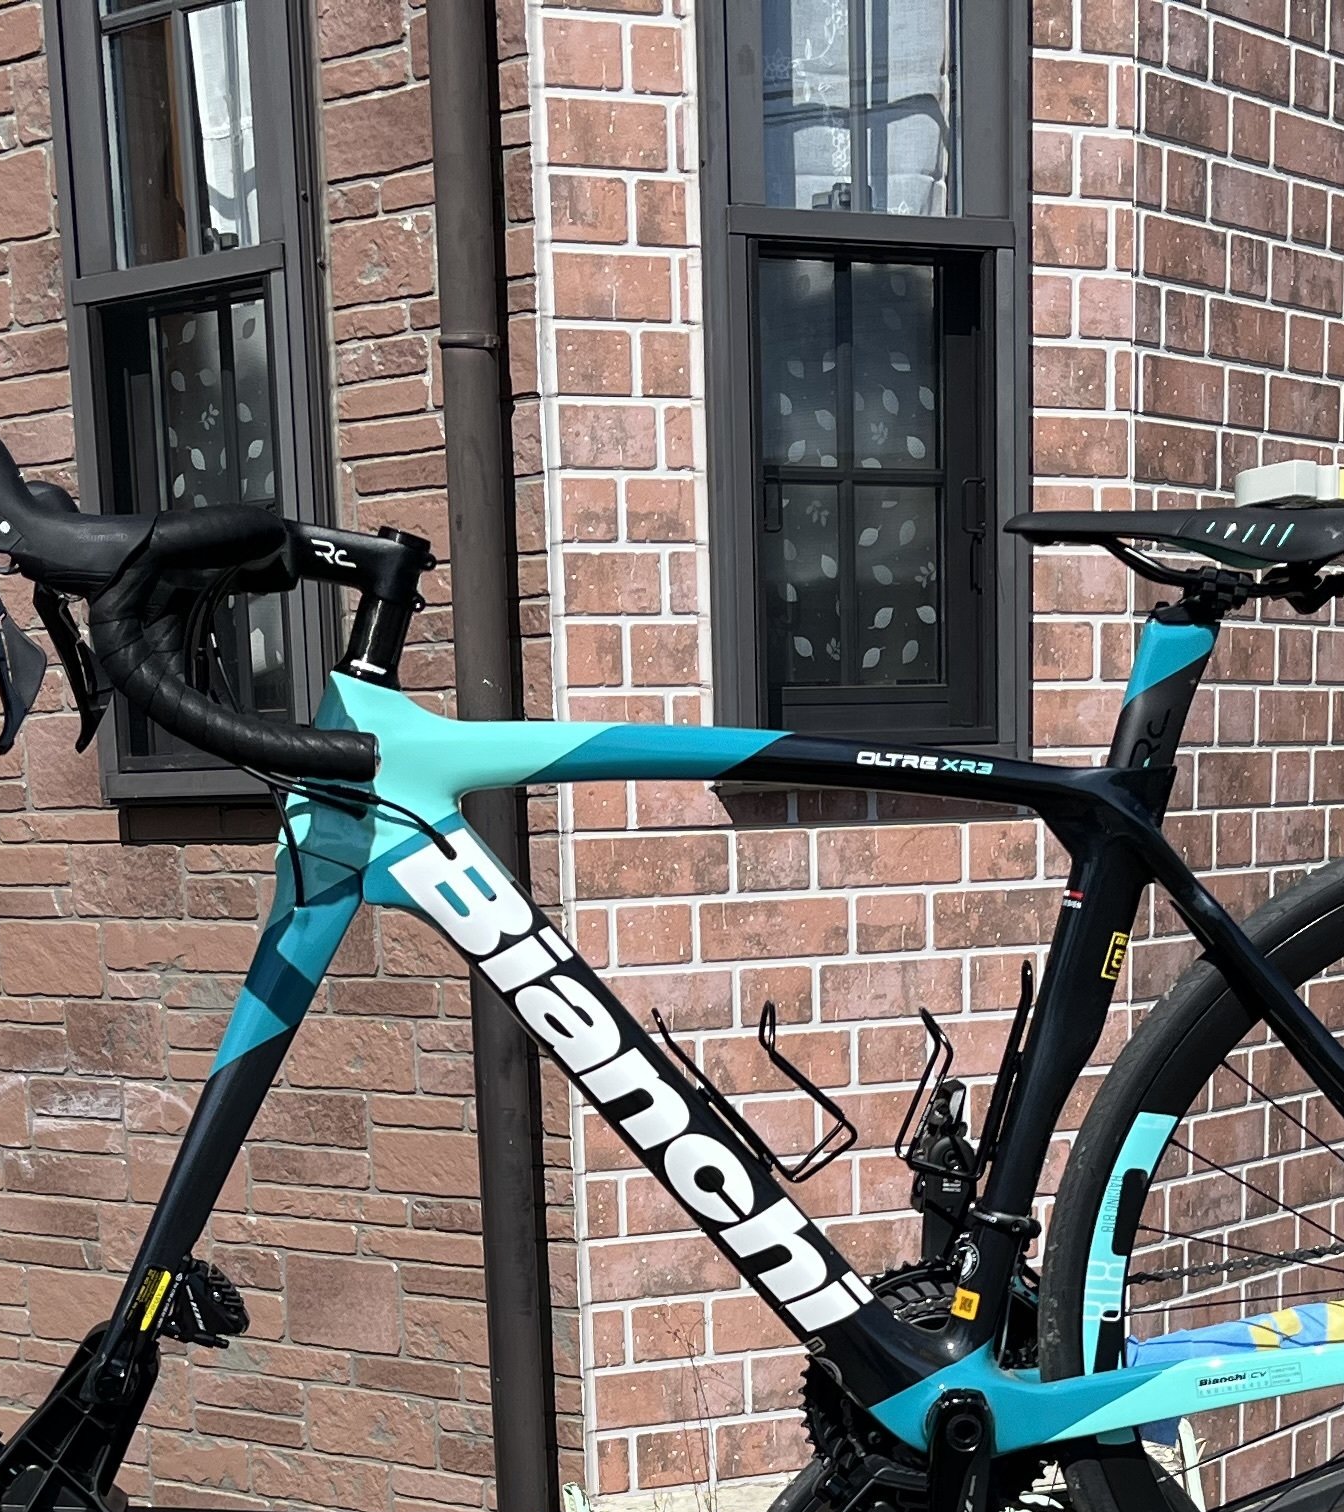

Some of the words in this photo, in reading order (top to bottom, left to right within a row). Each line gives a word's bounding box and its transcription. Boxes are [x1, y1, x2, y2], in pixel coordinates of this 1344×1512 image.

[856, 750, 939, 770] OLTRE
[940, 758, 994, 775] XR3
[387, 826, 875, 1334] Bianchi
[1198, 1372, 1247, 1387] Bianchi
